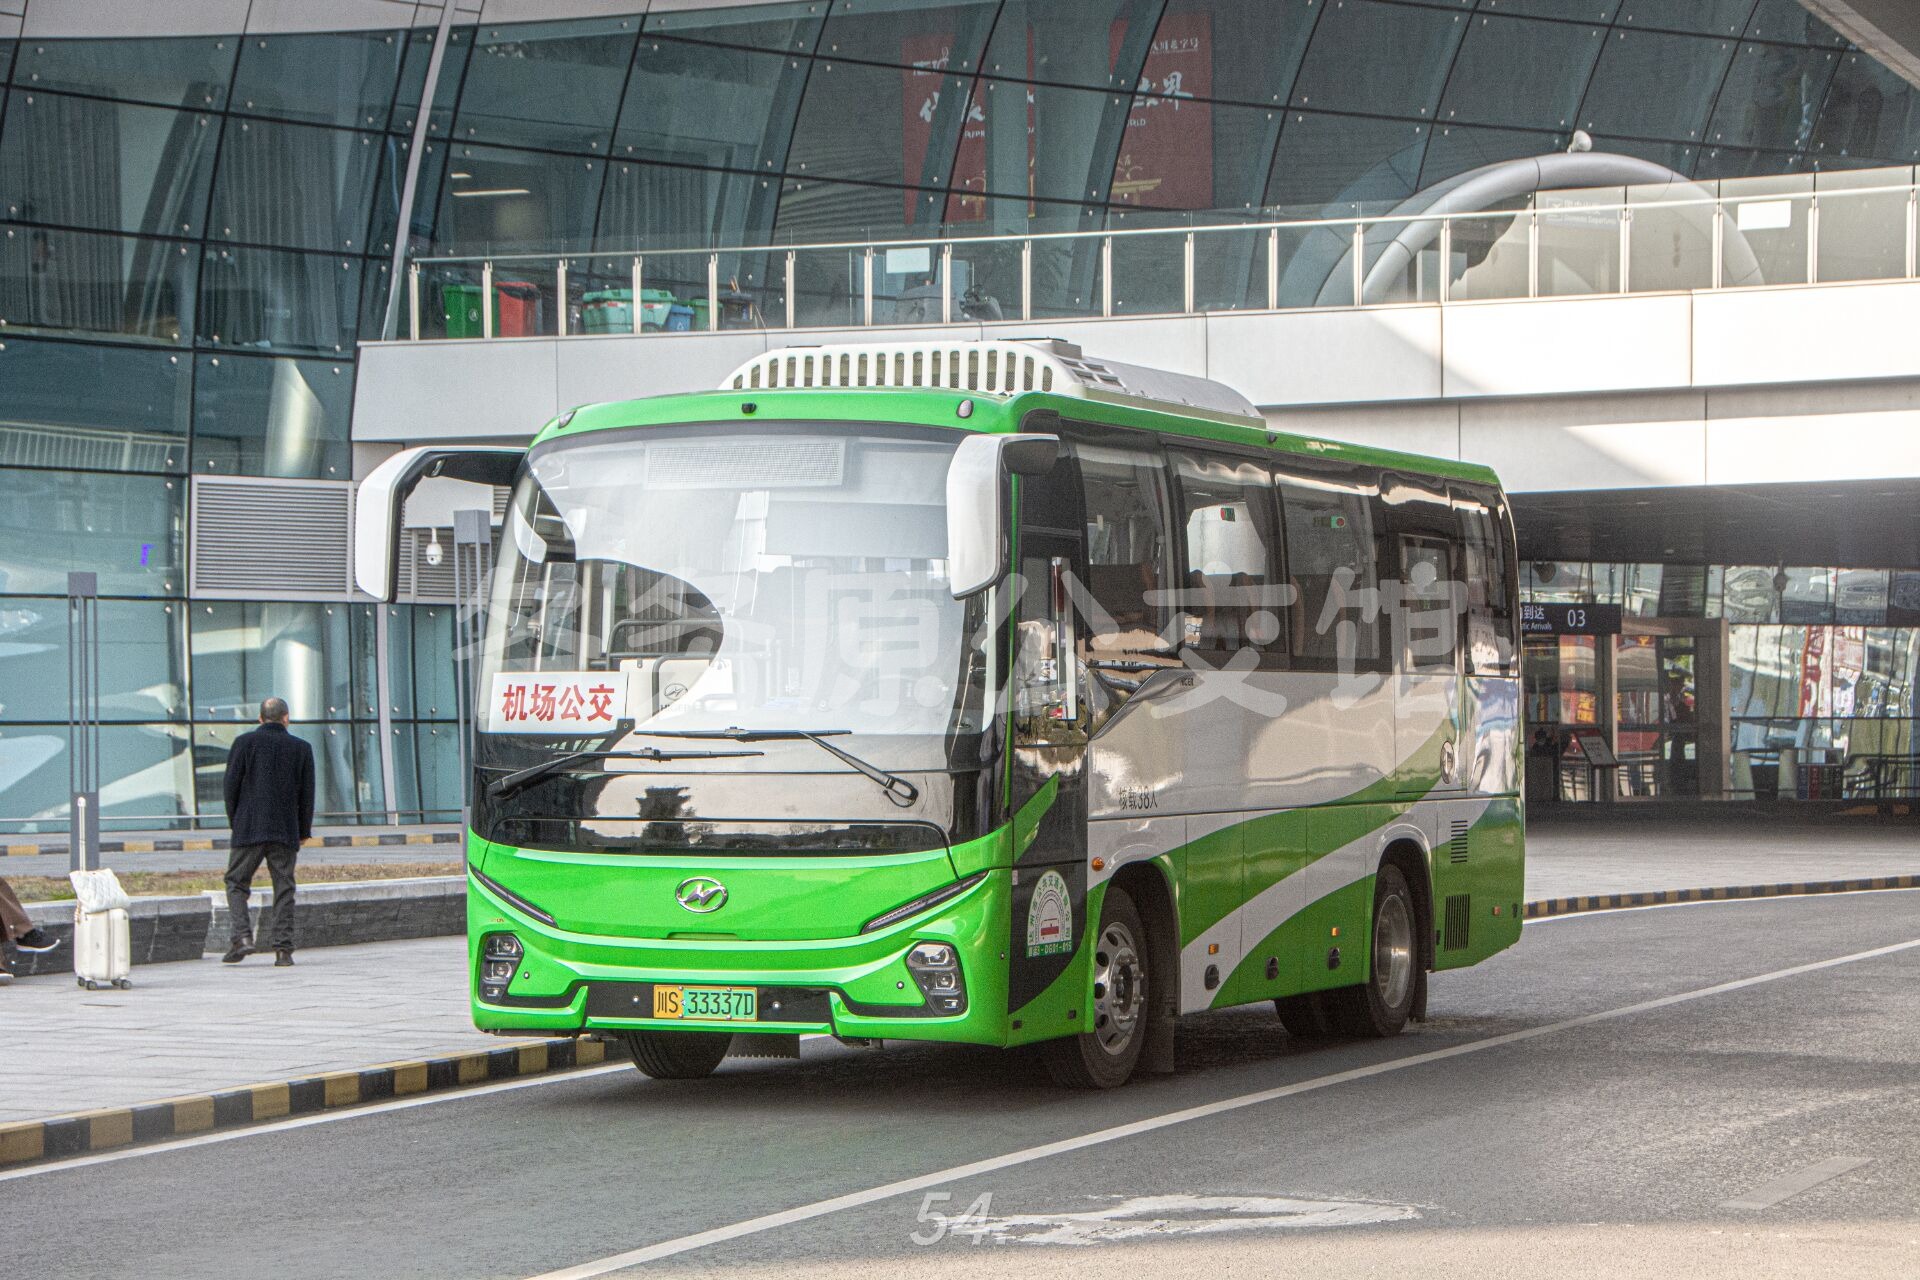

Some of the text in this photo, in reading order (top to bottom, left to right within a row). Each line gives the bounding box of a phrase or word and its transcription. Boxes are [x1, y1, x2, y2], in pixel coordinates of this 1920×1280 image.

[1531, 622, 1552, 631] Arrivals
[1567, 609, 1586, 627] 03
[502, 683, 615, 722] 机场公交
